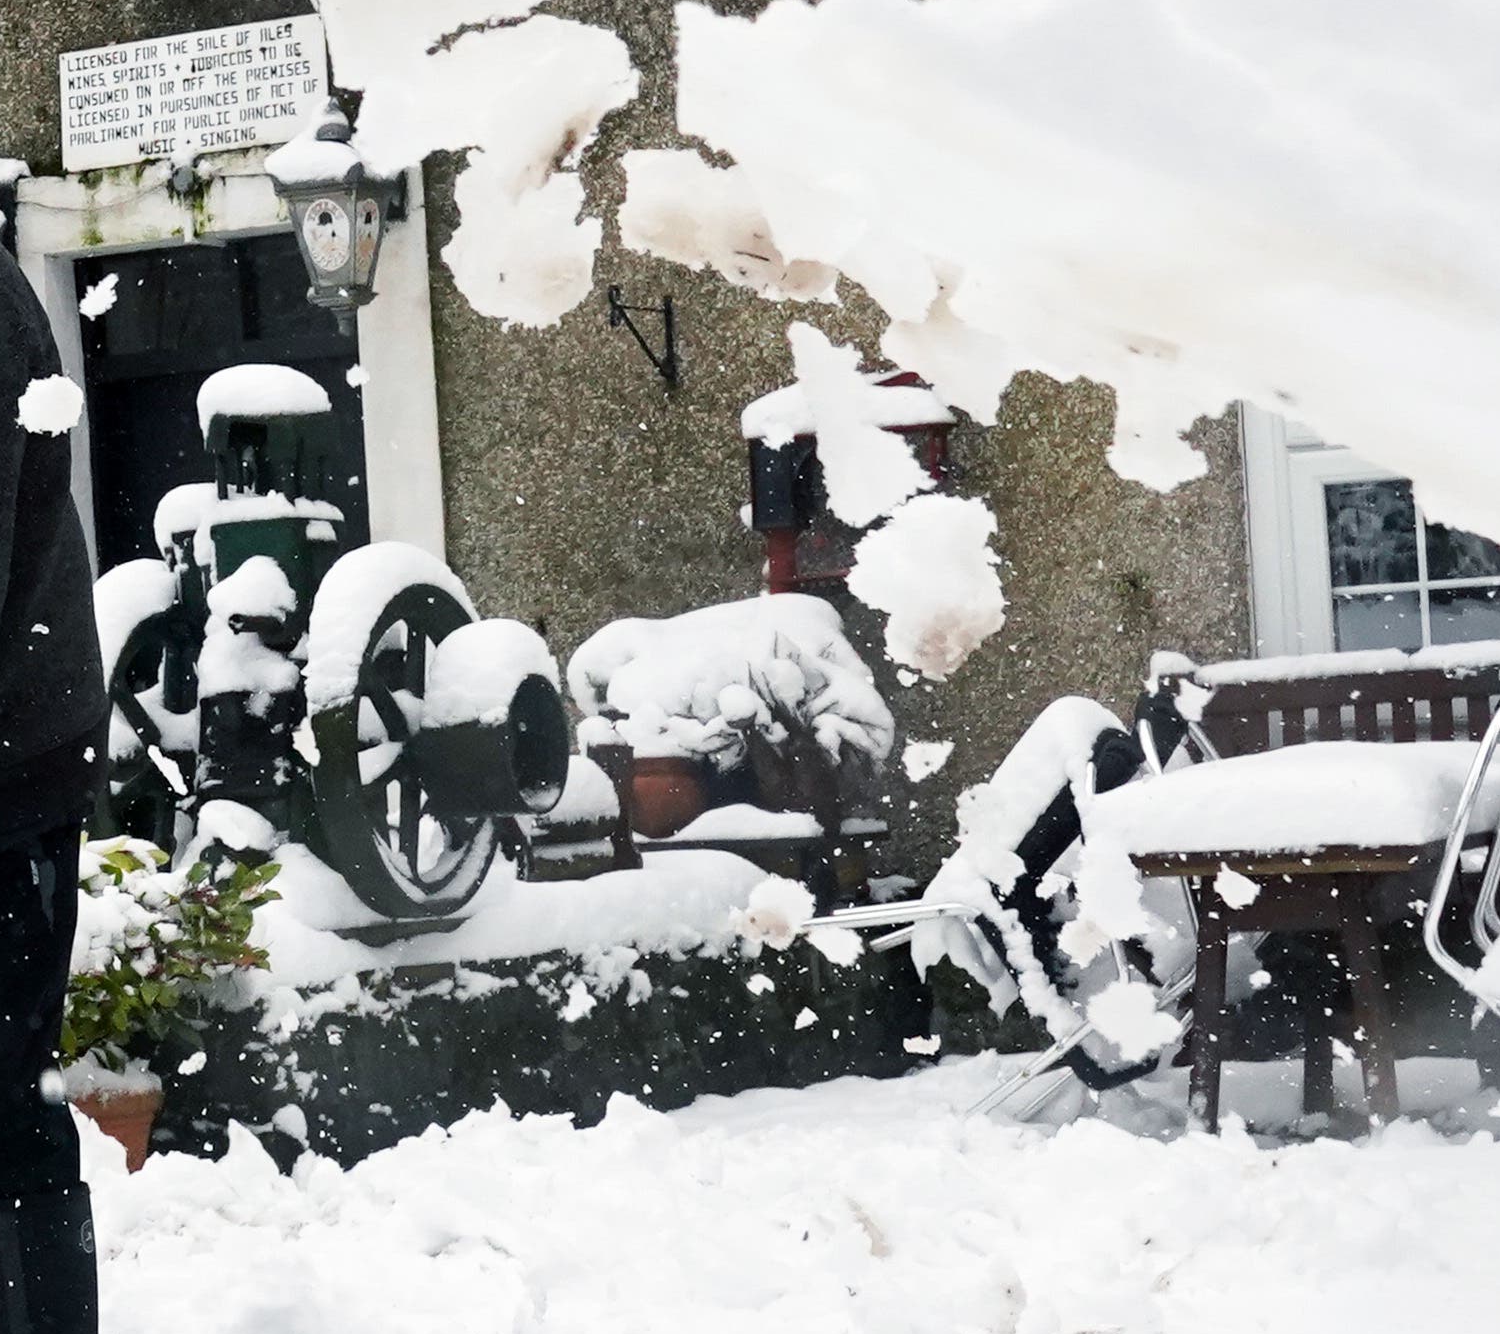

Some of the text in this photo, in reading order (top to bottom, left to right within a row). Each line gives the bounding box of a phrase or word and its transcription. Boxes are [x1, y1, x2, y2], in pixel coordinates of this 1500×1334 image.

[67, 22, 293, 72] LICENSED FOR THE SALE OF ALES
[113, 62, 167, 84] SPIRITS
[190, 48, 253, 74] TOBACCOS
[259, 46, 277, 62] TO
[285, 41, 302, 58] BE
[68, 60, 311, 110] CONSUMED ON OR OFF THE PREMISES
[69, 78, 318, 129] LICENSED IN PURSUANCES OF ACT OF
[69, 101, 297, 147] PARLIAMENT FOR PUBLIC DANCING
[138, 137, 177, 156] MUSIC
[200, 126, 256, 147] SINGING
